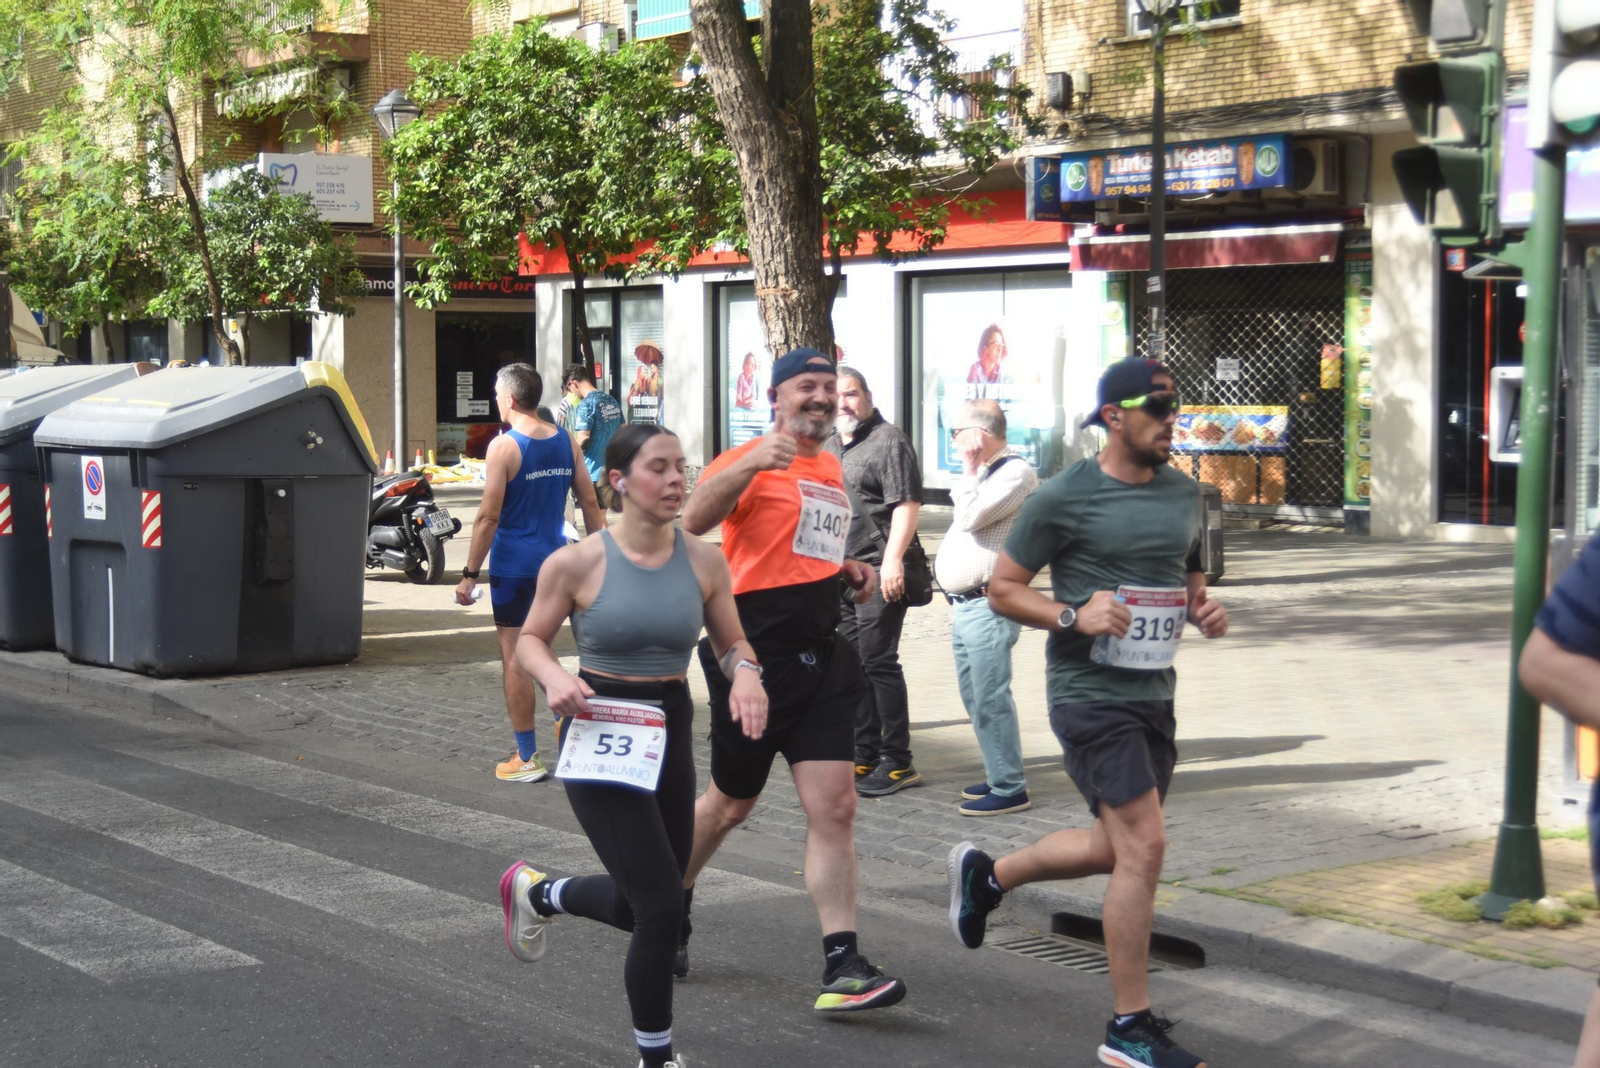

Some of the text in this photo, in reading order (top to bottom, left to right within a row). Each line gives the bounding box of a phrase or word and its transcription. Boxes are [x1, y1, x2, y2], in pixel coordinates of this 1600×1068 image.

[1173, 145, 1233, 168] Kebab
[1105, 186, 1123, 196] 957
[1124, 184, 1137, 194] 94
[500, 276, 536, 294] Tor
[813, 508, 842, 538] 140
[1131, 616, 1175, 641] 319
[591, 706, 610, 714] RRERA
[611, 707, 629, 716] MARÍA
[594, 733, 633, 756] 53
